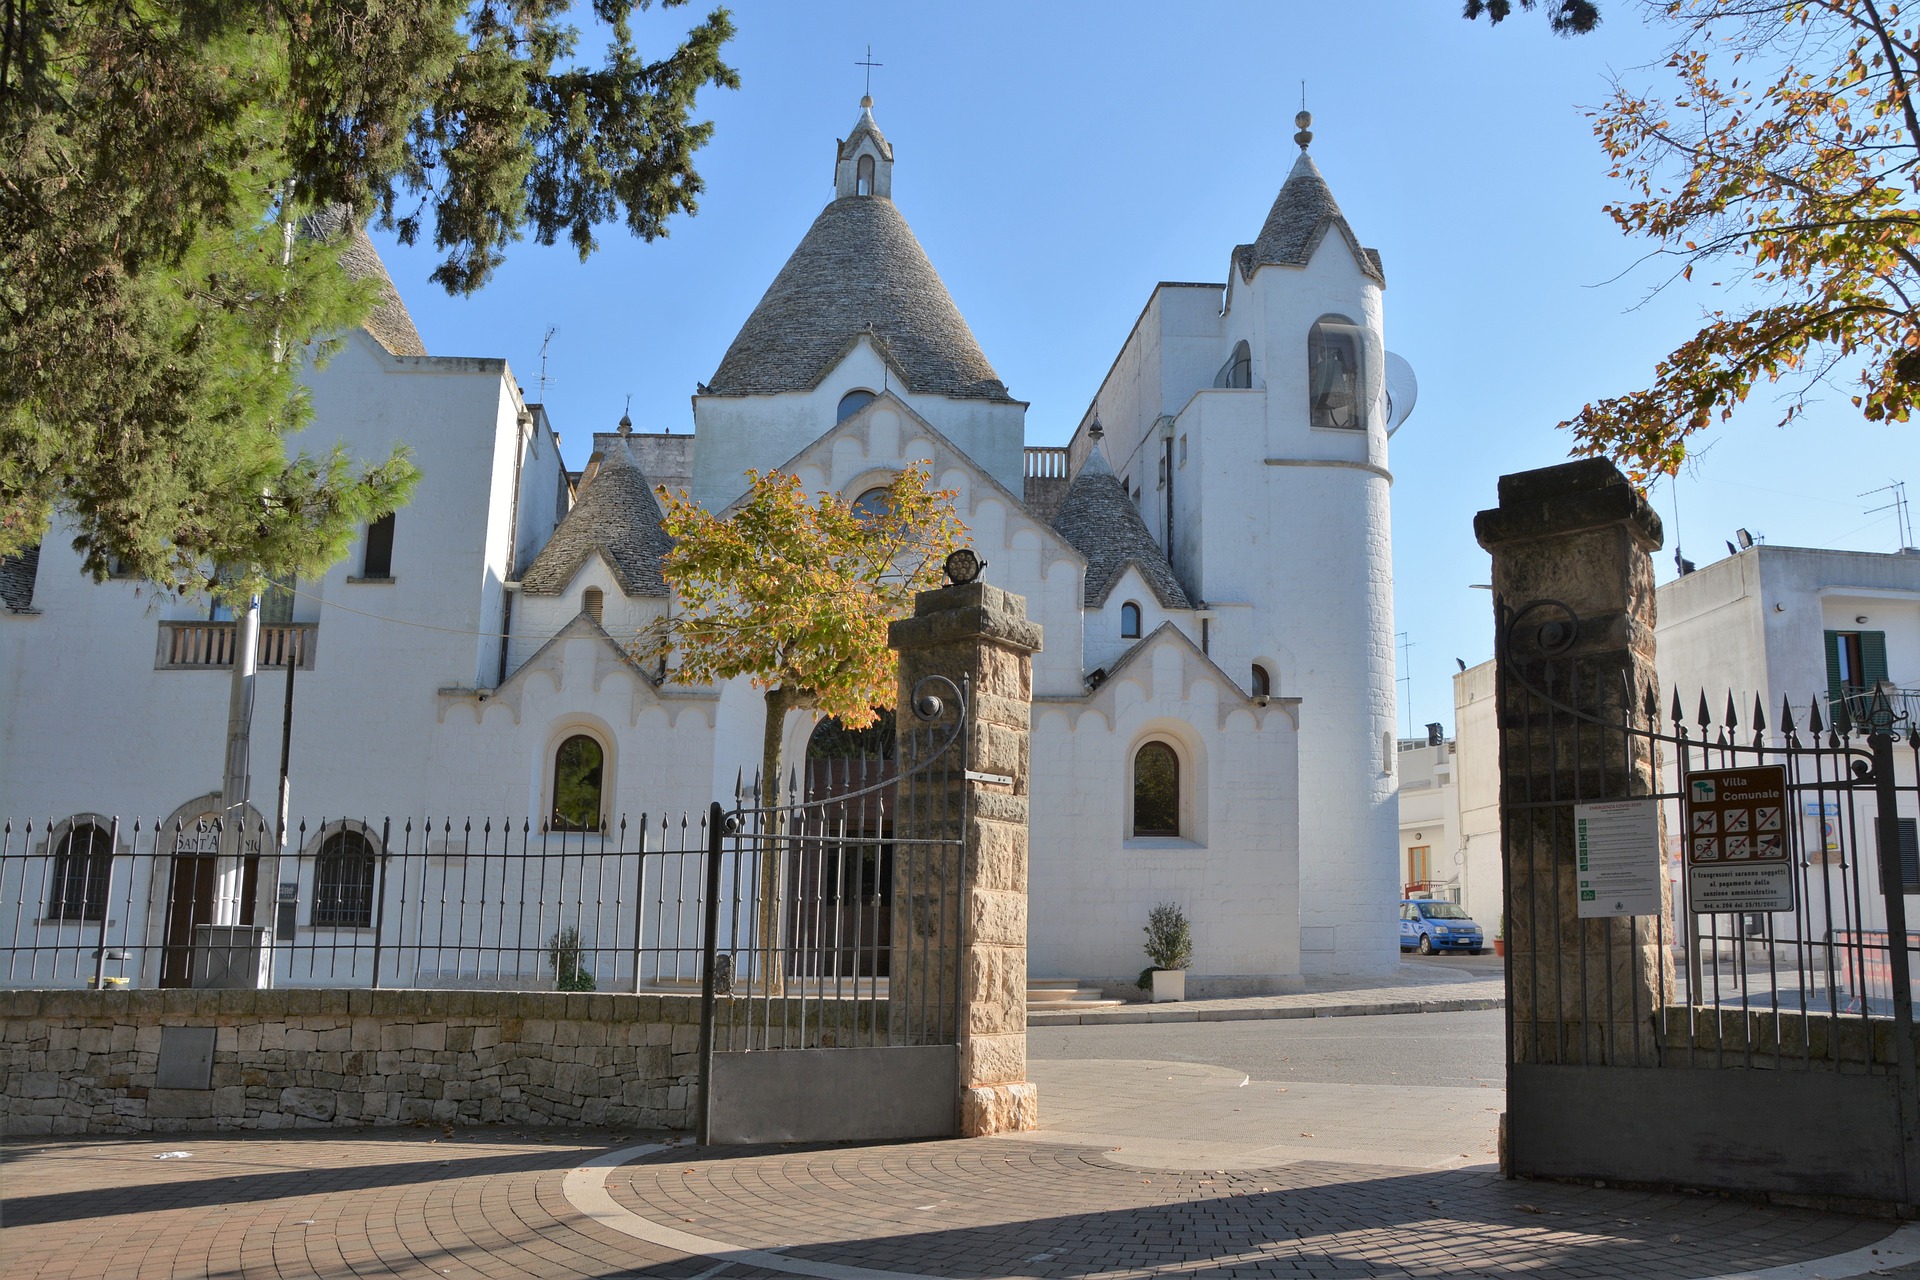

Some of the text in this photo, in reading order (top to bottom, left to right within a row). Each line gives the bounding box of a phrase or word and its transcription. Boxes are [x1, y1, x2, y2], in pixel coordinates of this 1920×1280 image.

[1723, 777, 1747, 786] Villa
[1723, 789, 1779, 801] Comunale
[1698, 870, 1733, 879] trasgressori
[1761, 868, 1786, 877] soggetti
[1719, 879, 1751, 888] pagamento
